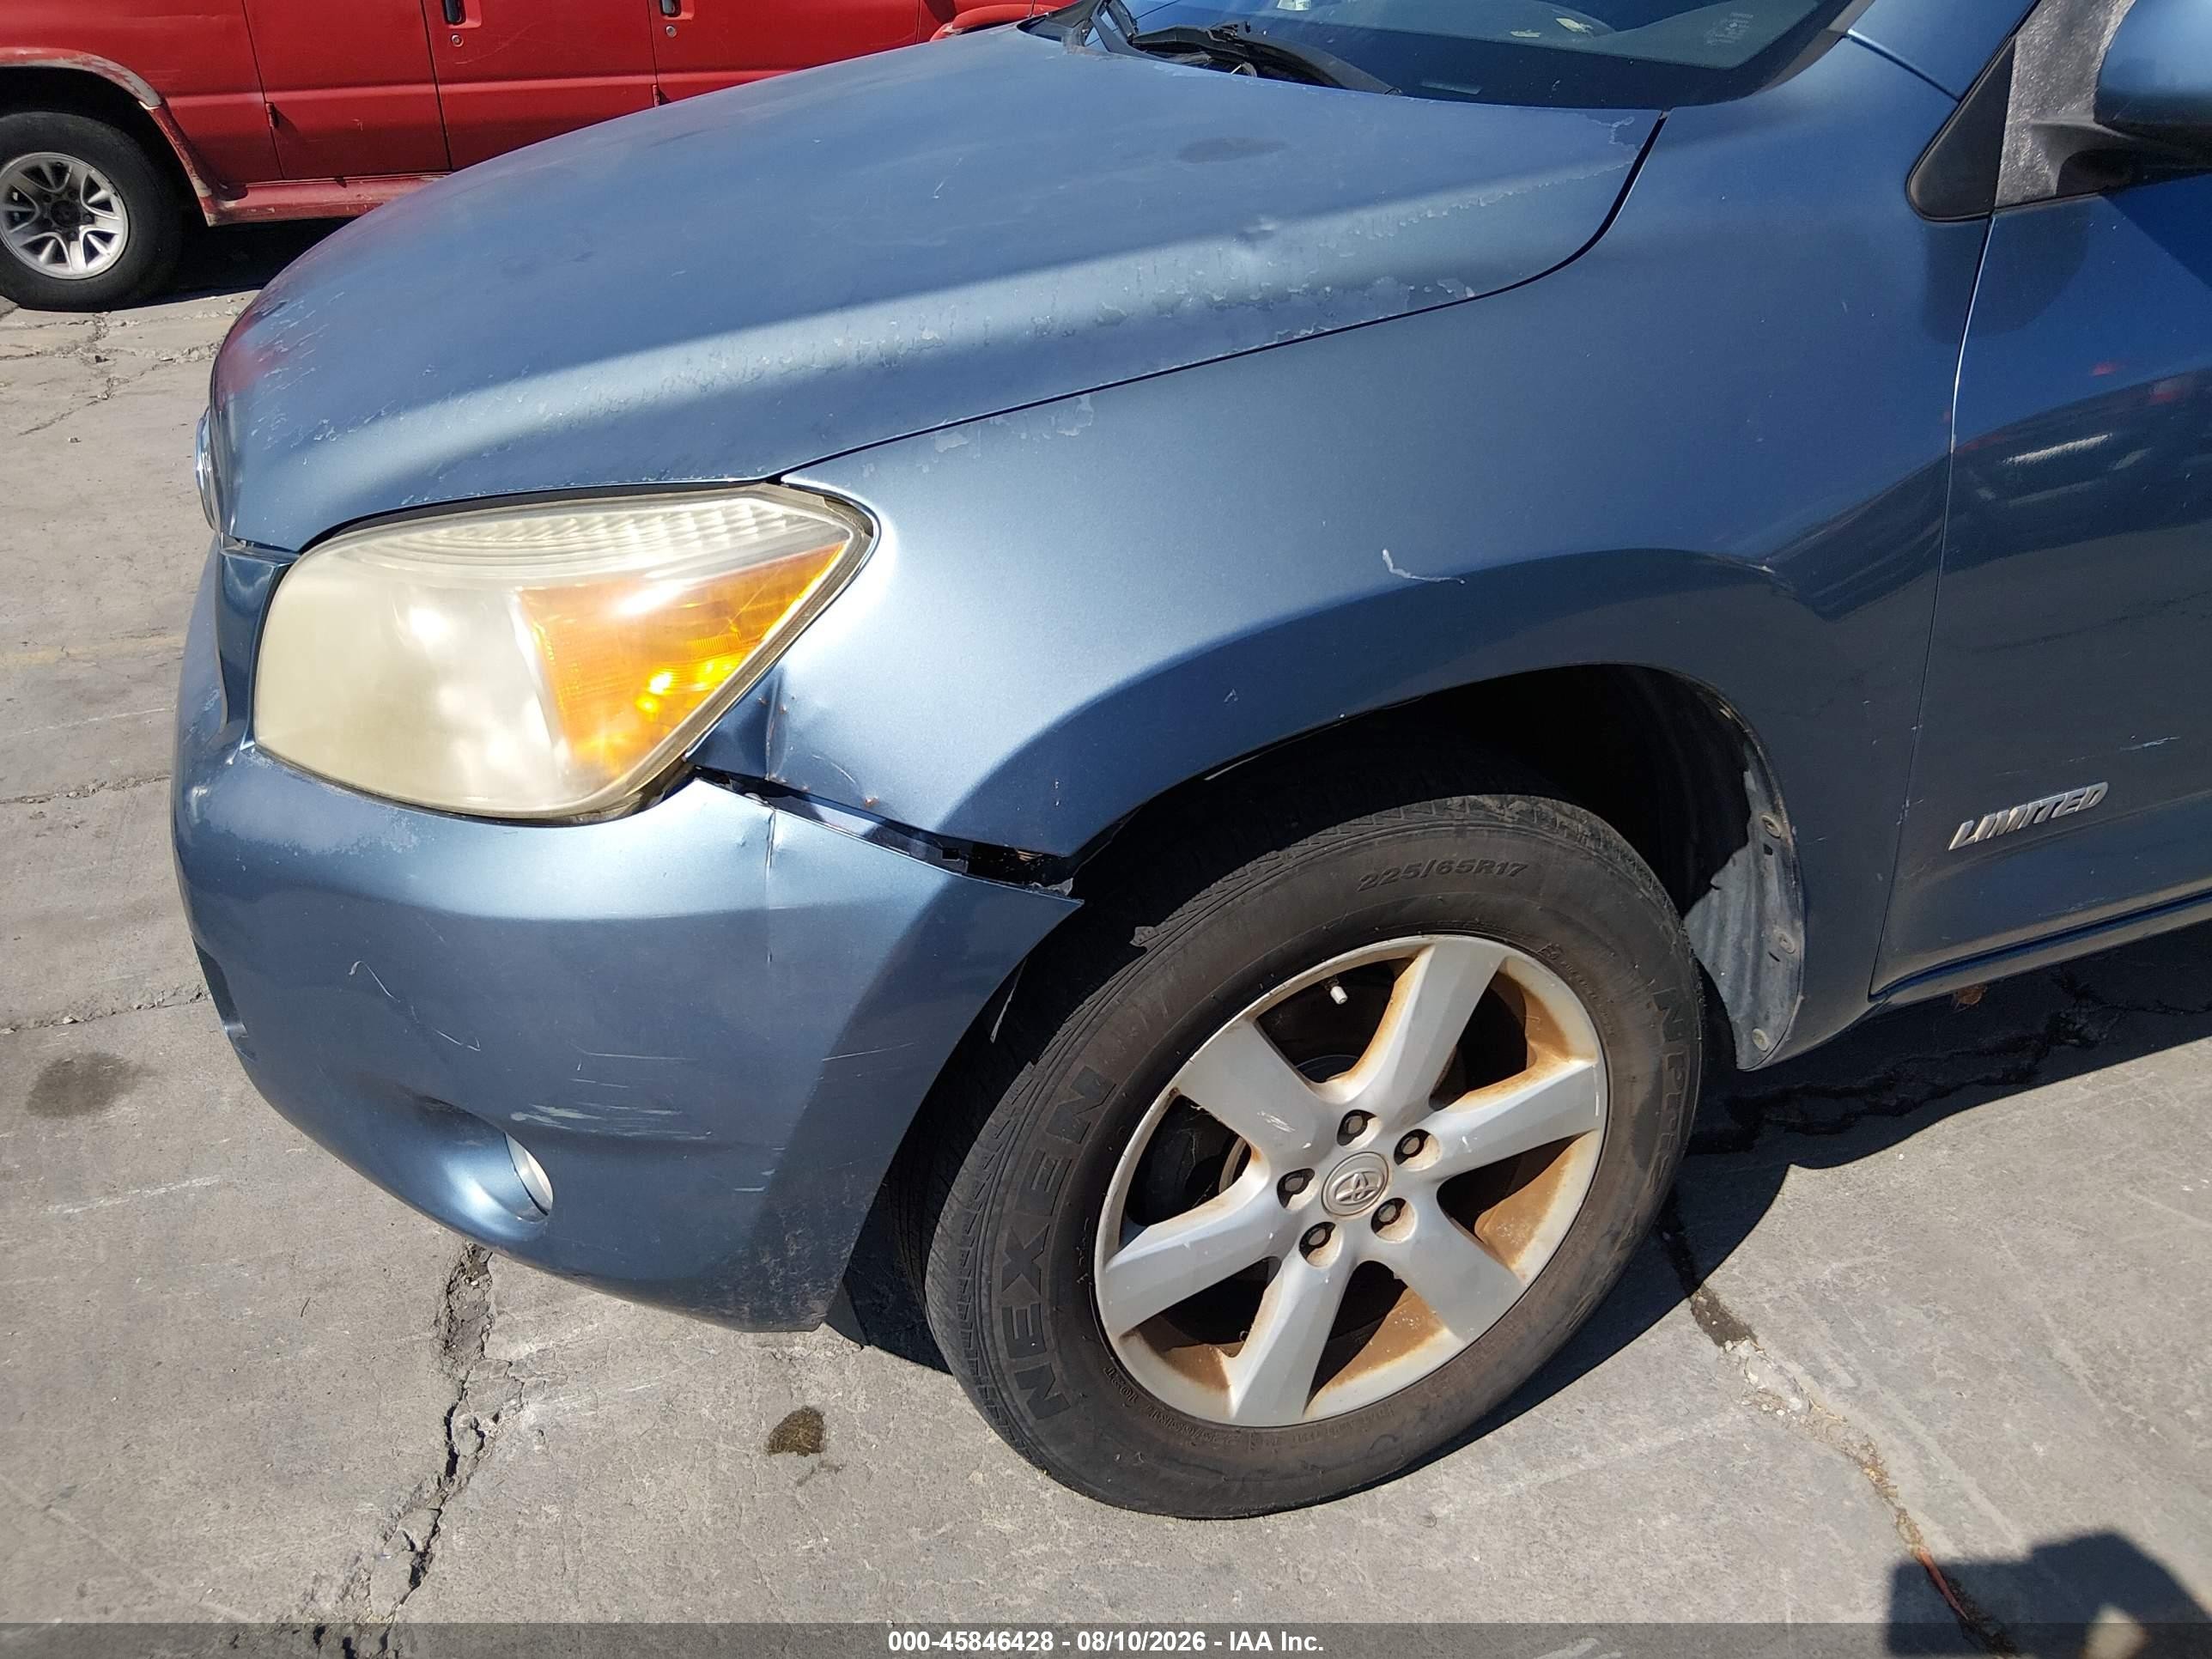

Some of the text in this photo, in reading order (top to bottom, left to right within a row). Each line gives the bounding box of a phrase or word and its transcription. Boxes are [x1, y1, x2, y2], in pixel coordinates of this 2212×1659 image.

[1948, 781, 2109, 851] LIMITED
[1356, 858, 1528, 892] 225/65R17
[1001, 1065, 1117, 1420] NEXEN
